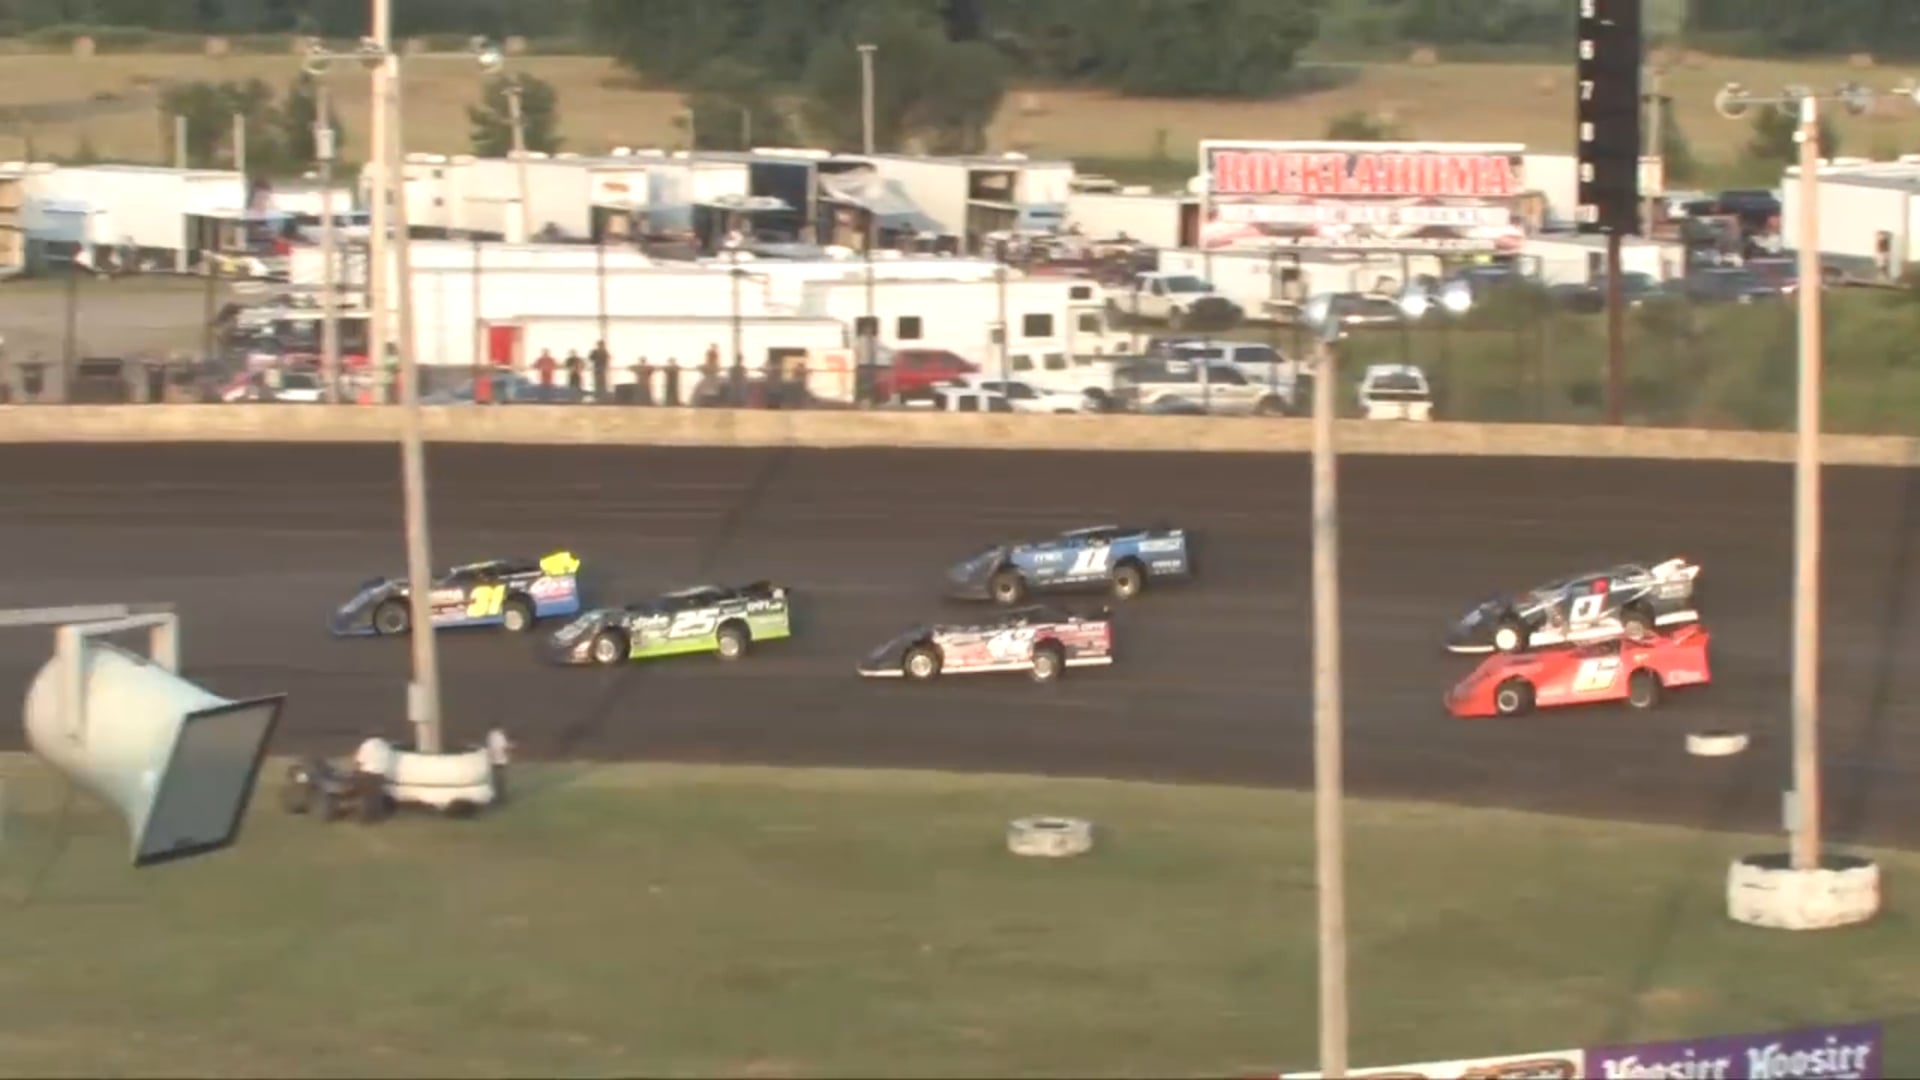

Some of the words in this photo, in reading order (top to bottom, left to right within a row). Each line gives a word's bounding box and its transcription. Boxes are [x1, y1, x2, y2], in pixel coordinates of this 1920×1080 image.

[1579, 80, 1595, 100] 7
[1215, 152, 1514, 194] ROCKLAHOMA
[668, 607, 720, 639] 25
